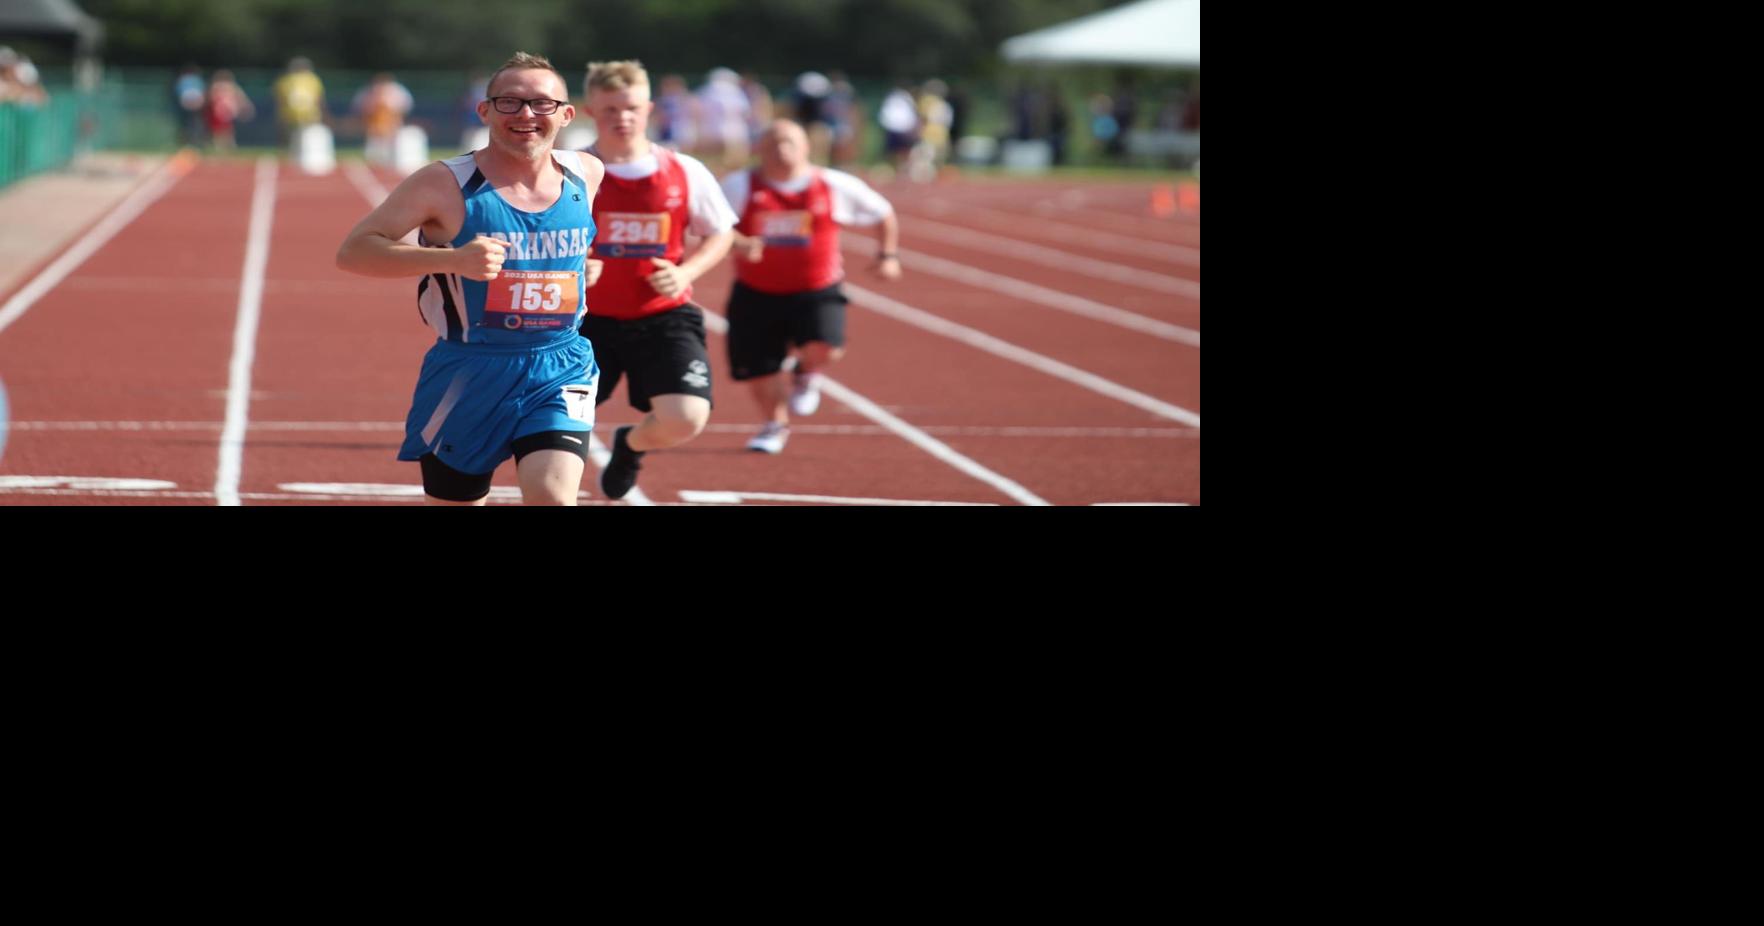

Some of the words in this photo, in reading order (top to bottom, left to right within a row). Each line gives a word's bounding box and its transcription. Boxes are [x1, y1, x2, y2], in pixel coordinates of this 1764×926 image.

[475, 227, 589, 260] KANSAS
[608, 220, 658, 243] 294
[508, 282, 561, 311] 153
